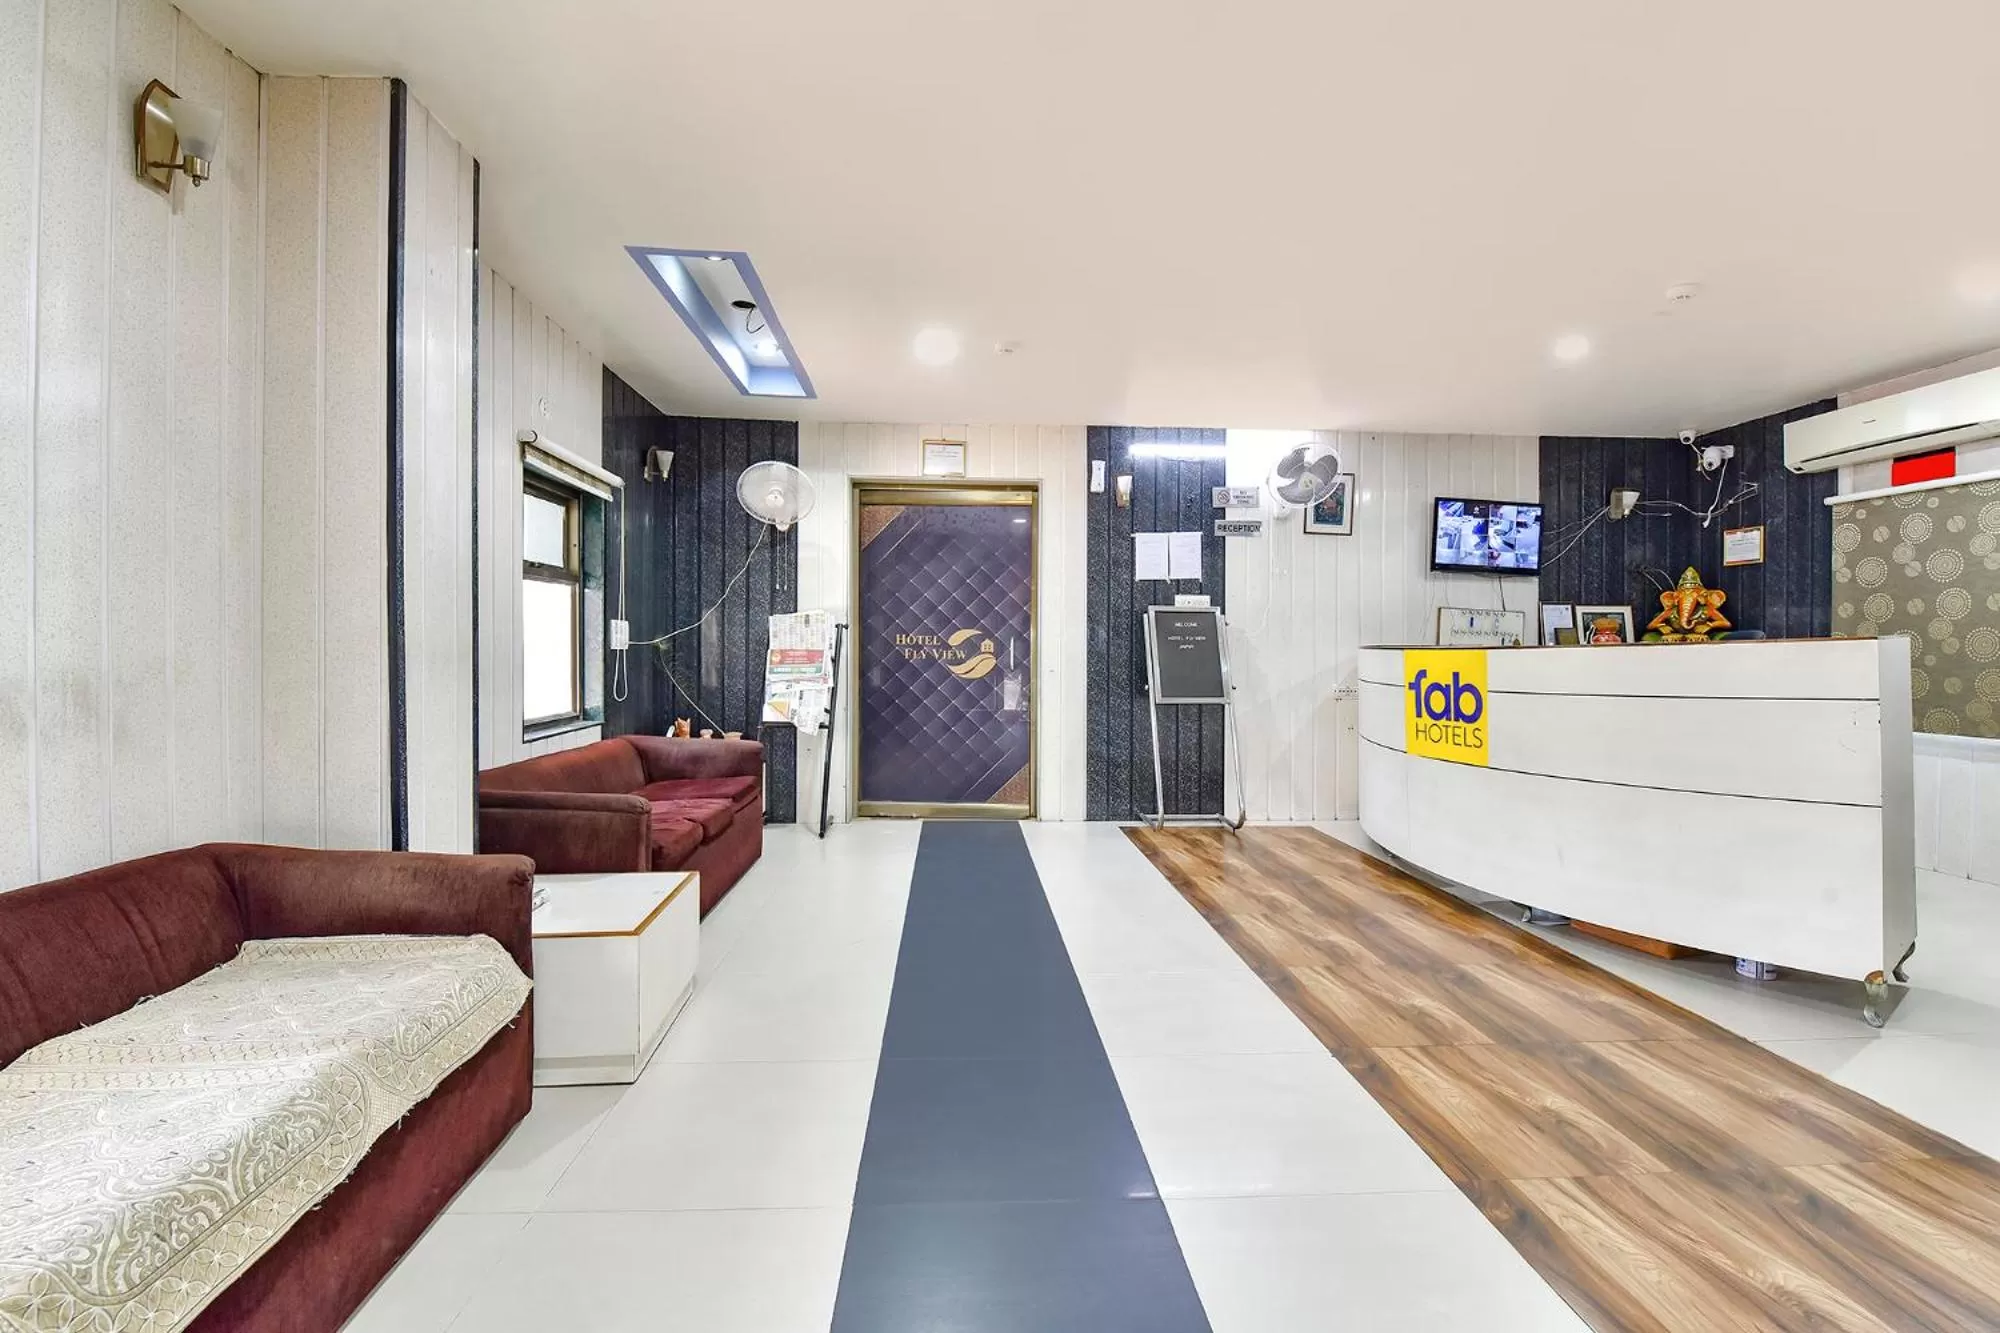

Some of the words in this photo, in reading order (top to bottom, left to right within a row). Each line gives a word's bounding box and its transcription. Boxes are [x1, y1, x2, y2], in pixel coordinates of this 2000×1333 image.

[1216, 524, 1261, 533] RECEPTION
[895, 633, 941, 646] HOTEL
[931, 648, 966, 660] VIEW
[1408, 669, 1483, 724] fab
[1415, 721, 1483, 749] HOTELS
